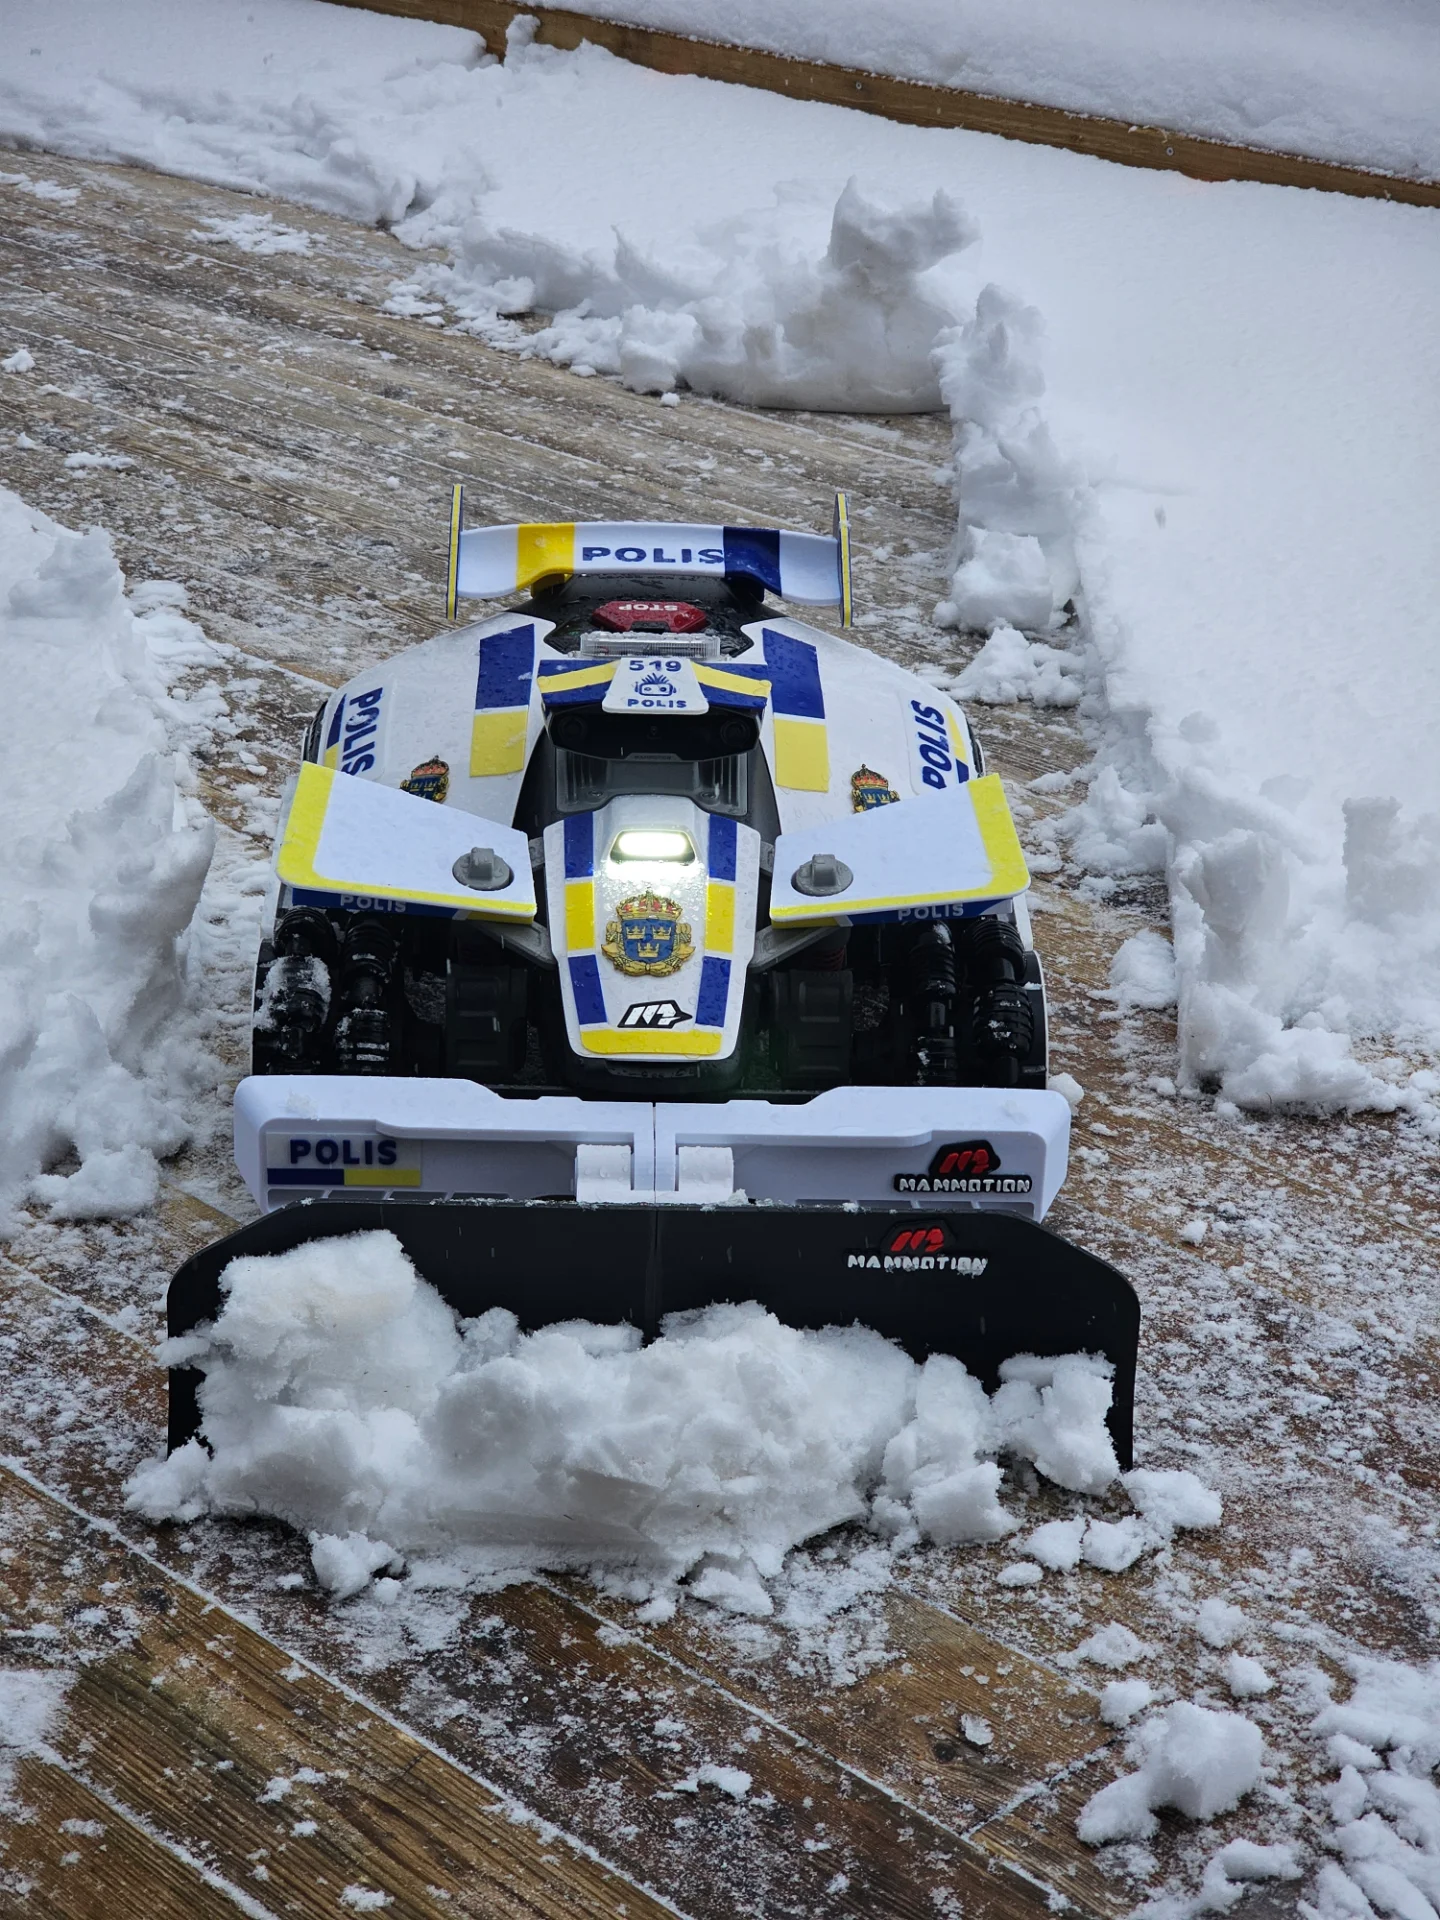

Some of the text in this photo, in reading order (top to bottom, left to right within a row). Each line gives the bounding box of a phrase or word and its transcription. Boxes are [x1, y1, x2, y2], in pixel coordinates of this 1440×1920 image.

[582, 547, 725, 564] POLIS
[619, 603, 678, 612] STOP
[629, 659, 682, 672] 519
[627, 698, 687, 708] POLIS
[341, 687, 384, 776] POLIS
[910, 700, 952, 789] POLIS
[340, 893, 406, 913] POLIS
[898, 903, 964, 921] POLIS
[290, 1139, 397, 1165] POLIS
[899, 1178, 1030, 1193] MAMMOTION
[847, 1254, 988, 1272] MAMMOTION
